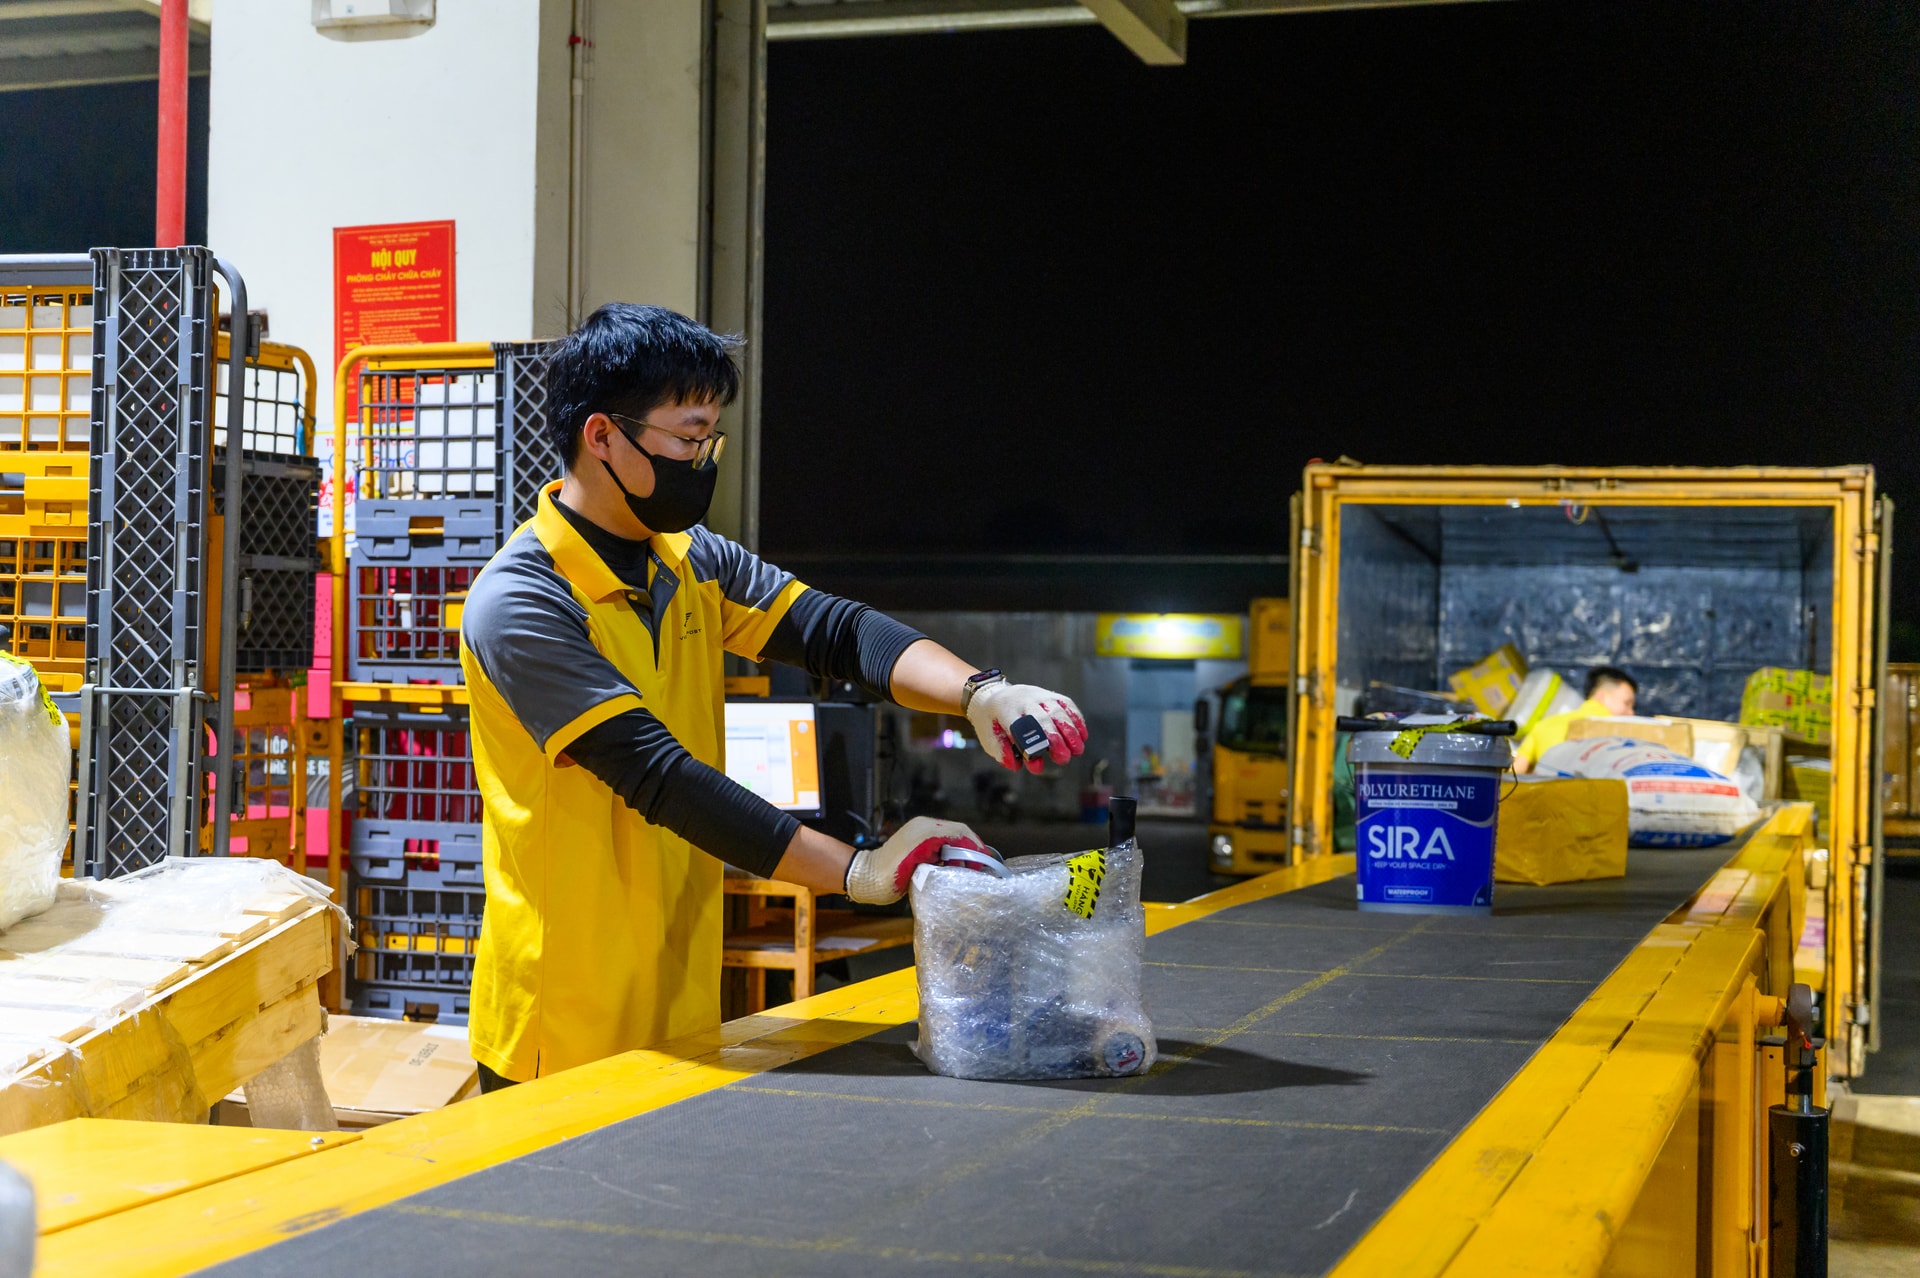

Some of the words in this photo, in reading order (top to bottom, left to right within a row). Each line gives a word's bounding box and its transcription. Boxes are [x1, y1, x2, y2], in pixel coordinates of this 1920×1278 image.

[371, 247, 392, 271] NỘI
[394, 248, 417, 268] QUY
[346, 273, 374, 283] PHÒNG
[375, 270, 397, 281] CHÁY
[420, 267, 442, 279] CHÁY
[1368, 825, 1455, 860] SIRA
[1374, 861, 1388, 869] KEEP
[1389, 861, 1407, 869] YOUR
[1408, 862, 1432, 870] SPACE
[1387, 888, 1429, 897] WATERPROOF
